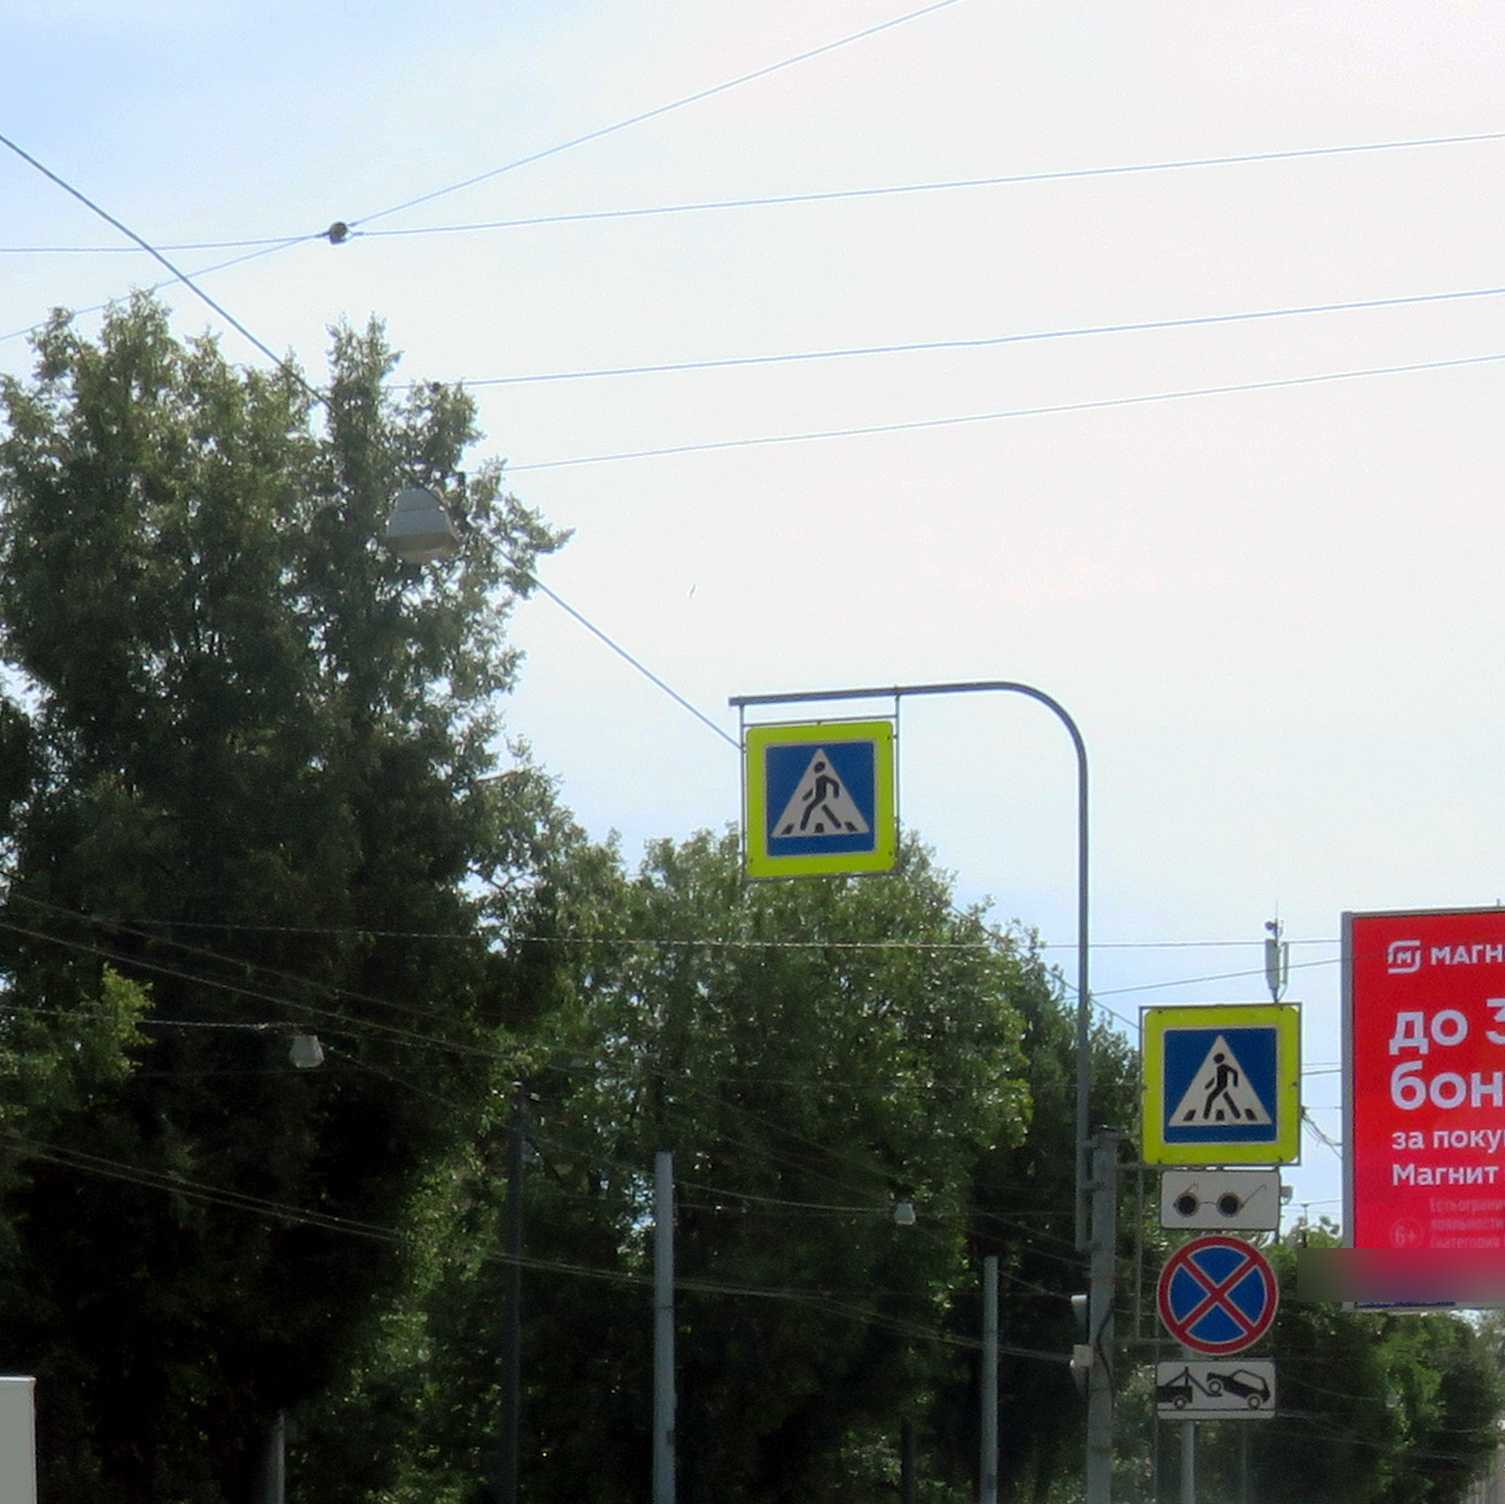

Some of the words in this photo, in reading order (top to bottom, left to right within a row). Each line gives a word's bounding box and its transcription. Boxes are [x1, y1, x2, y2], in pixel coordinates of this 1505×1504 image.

[1389, 1008, 1468, 1055] до
[1392, 1131, 1424, 1150] за
[1392, 1163, 1499, 1186] Магнит
